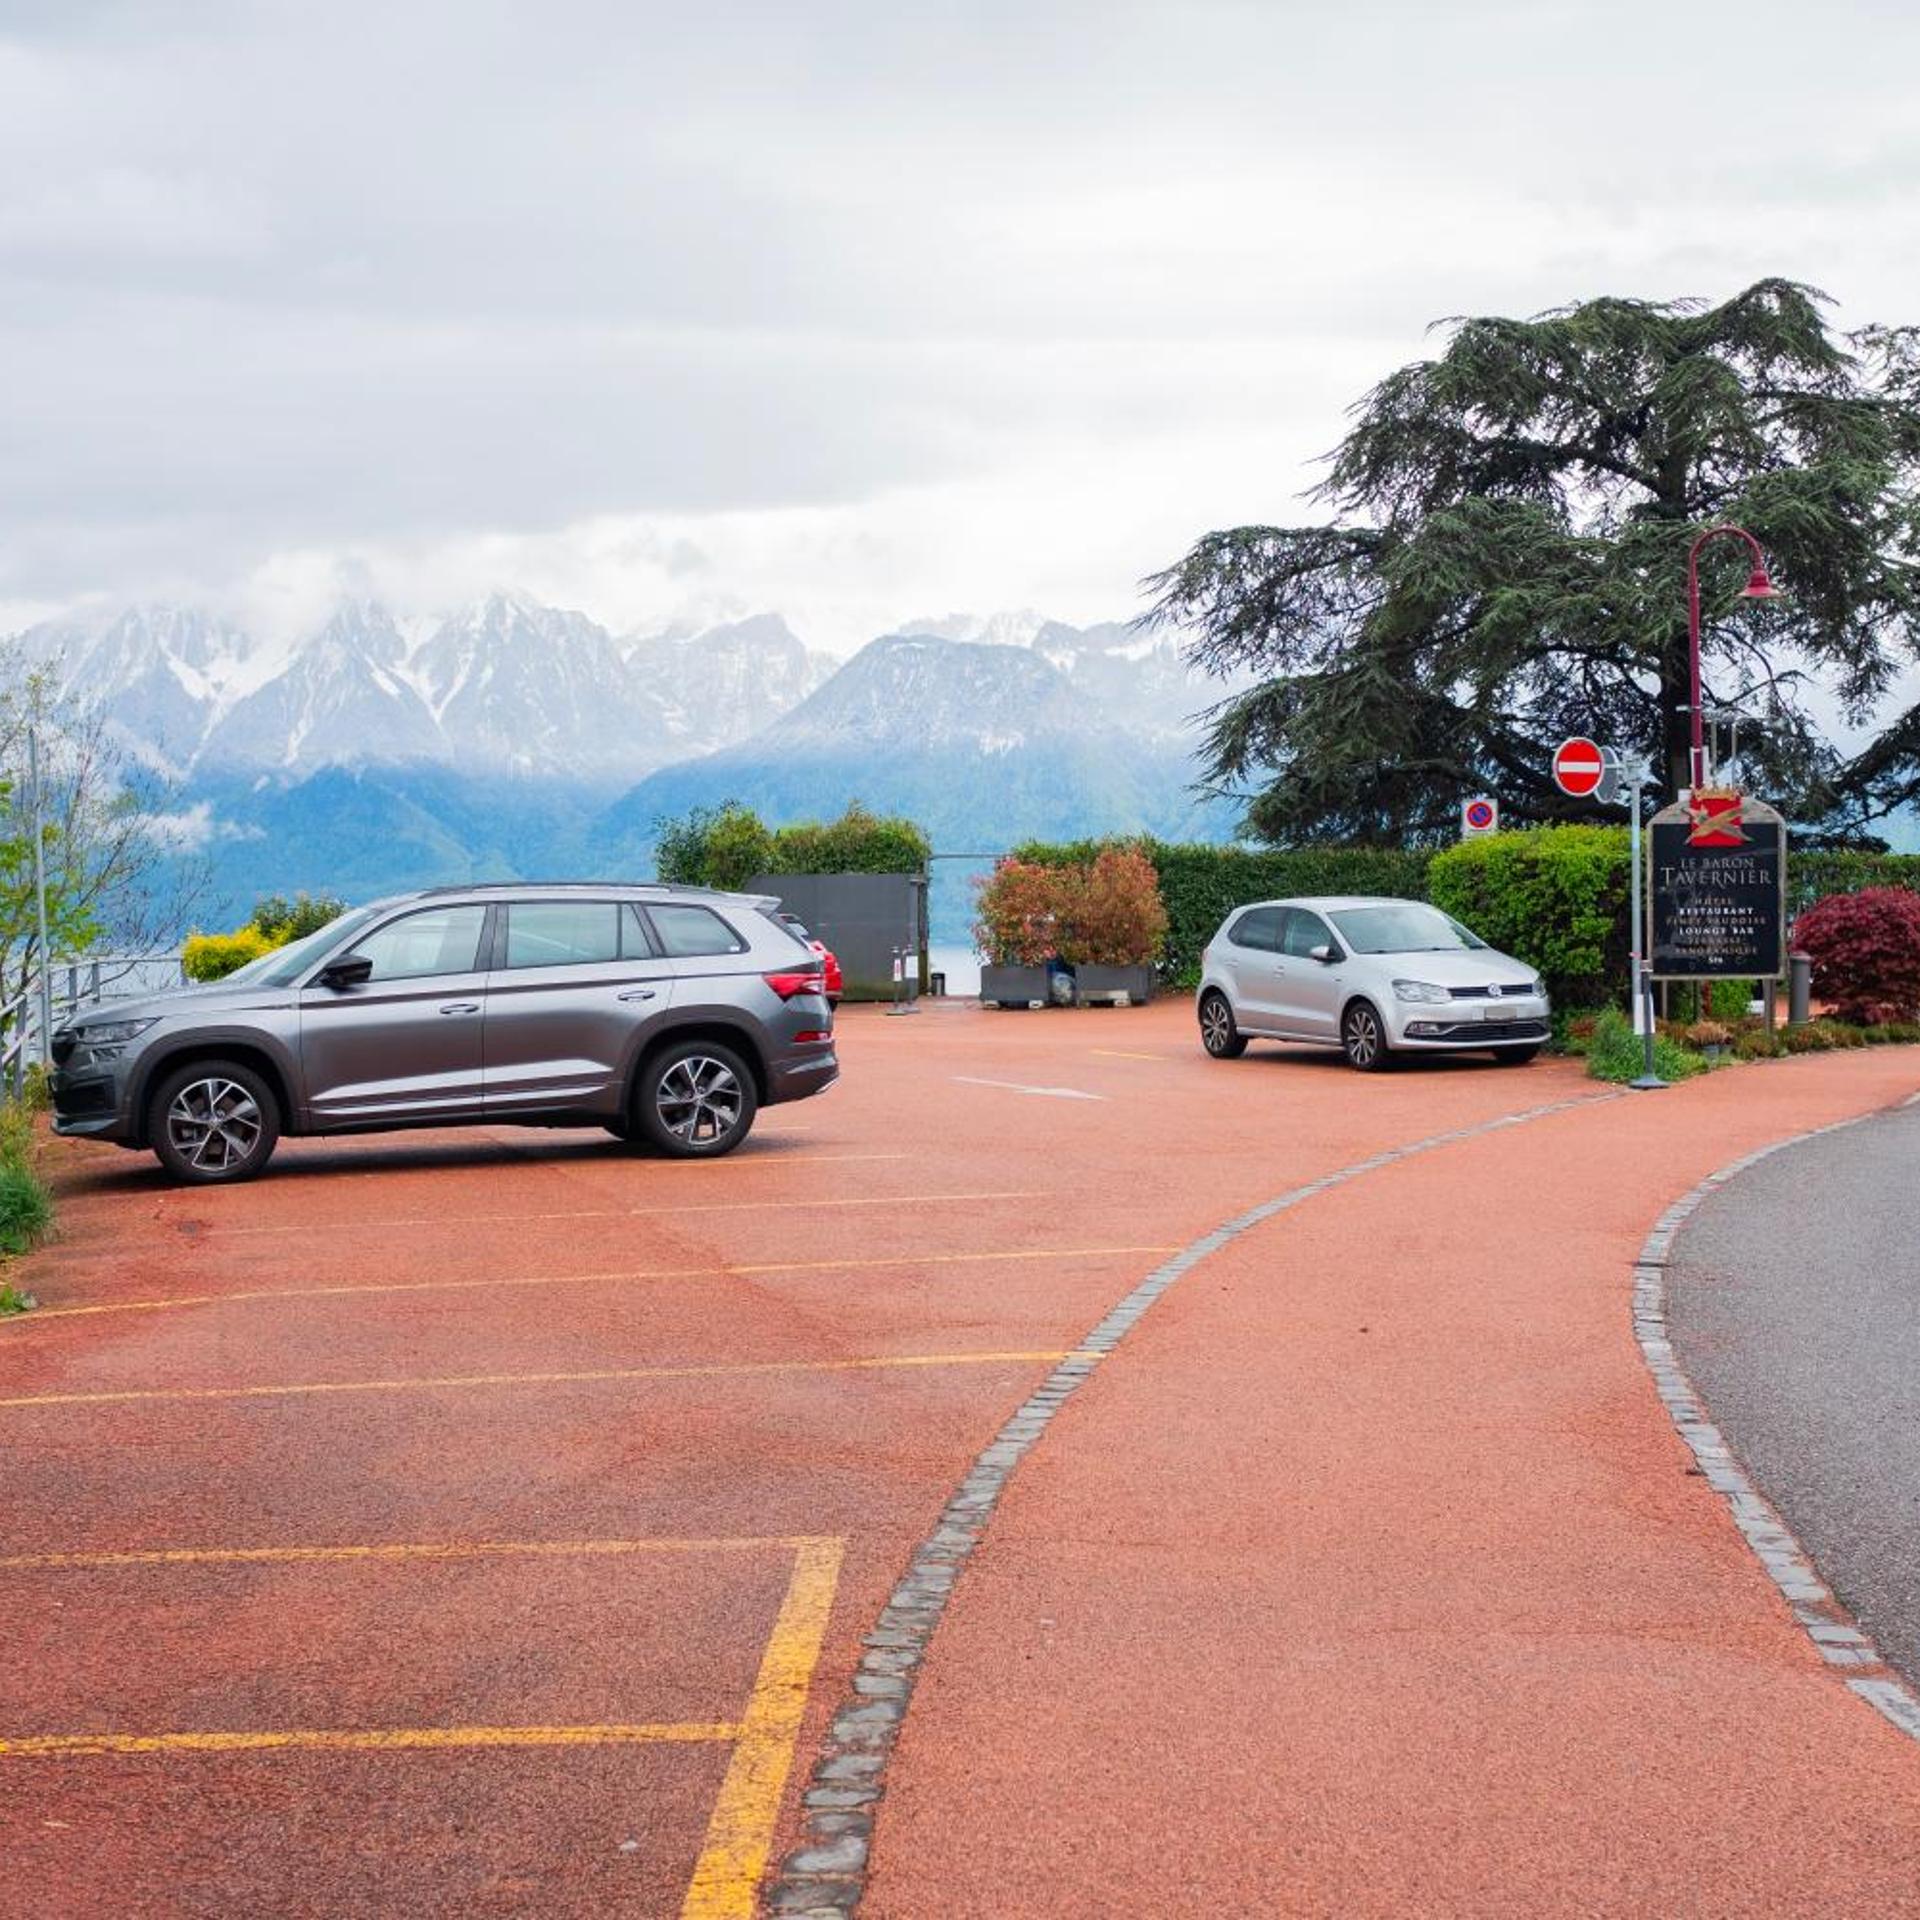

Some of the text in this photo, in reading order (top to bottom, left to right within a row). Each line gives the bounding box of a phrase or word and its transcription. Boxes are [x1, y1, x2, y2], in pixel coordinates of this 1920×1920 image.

[1681, 857, 1755, 868] LE BARON
[1660, 867, 1772, 888] TAVERNIER
[1680, 907, 1754, 915] RESTAURANT
[1680, 926, 1754, 936] LOUNGE BAR
